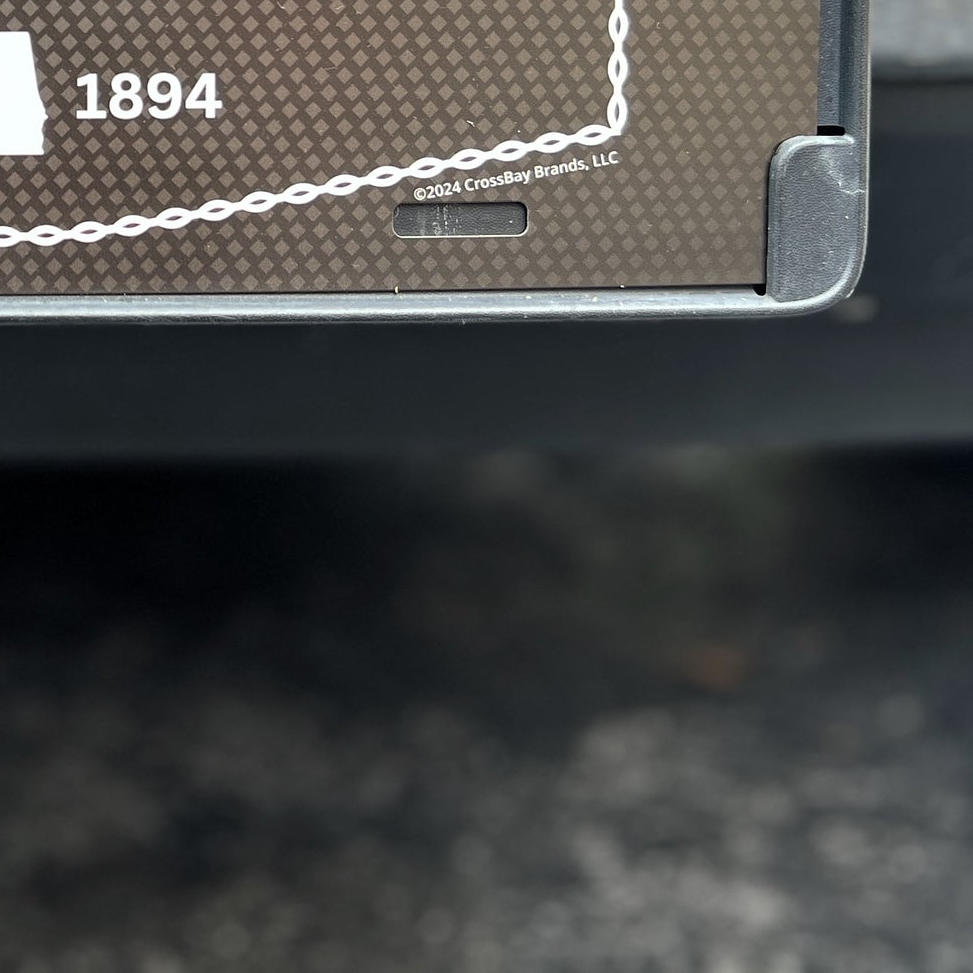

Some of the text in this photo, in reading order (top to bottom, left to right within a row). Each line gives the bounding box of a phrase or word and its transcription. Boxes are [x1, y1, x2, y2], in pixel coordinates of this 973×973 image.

[75, 72, 223, 120] 1894
[413, 150, 620, 201] ©2024 CrossBay Brands, LLC
